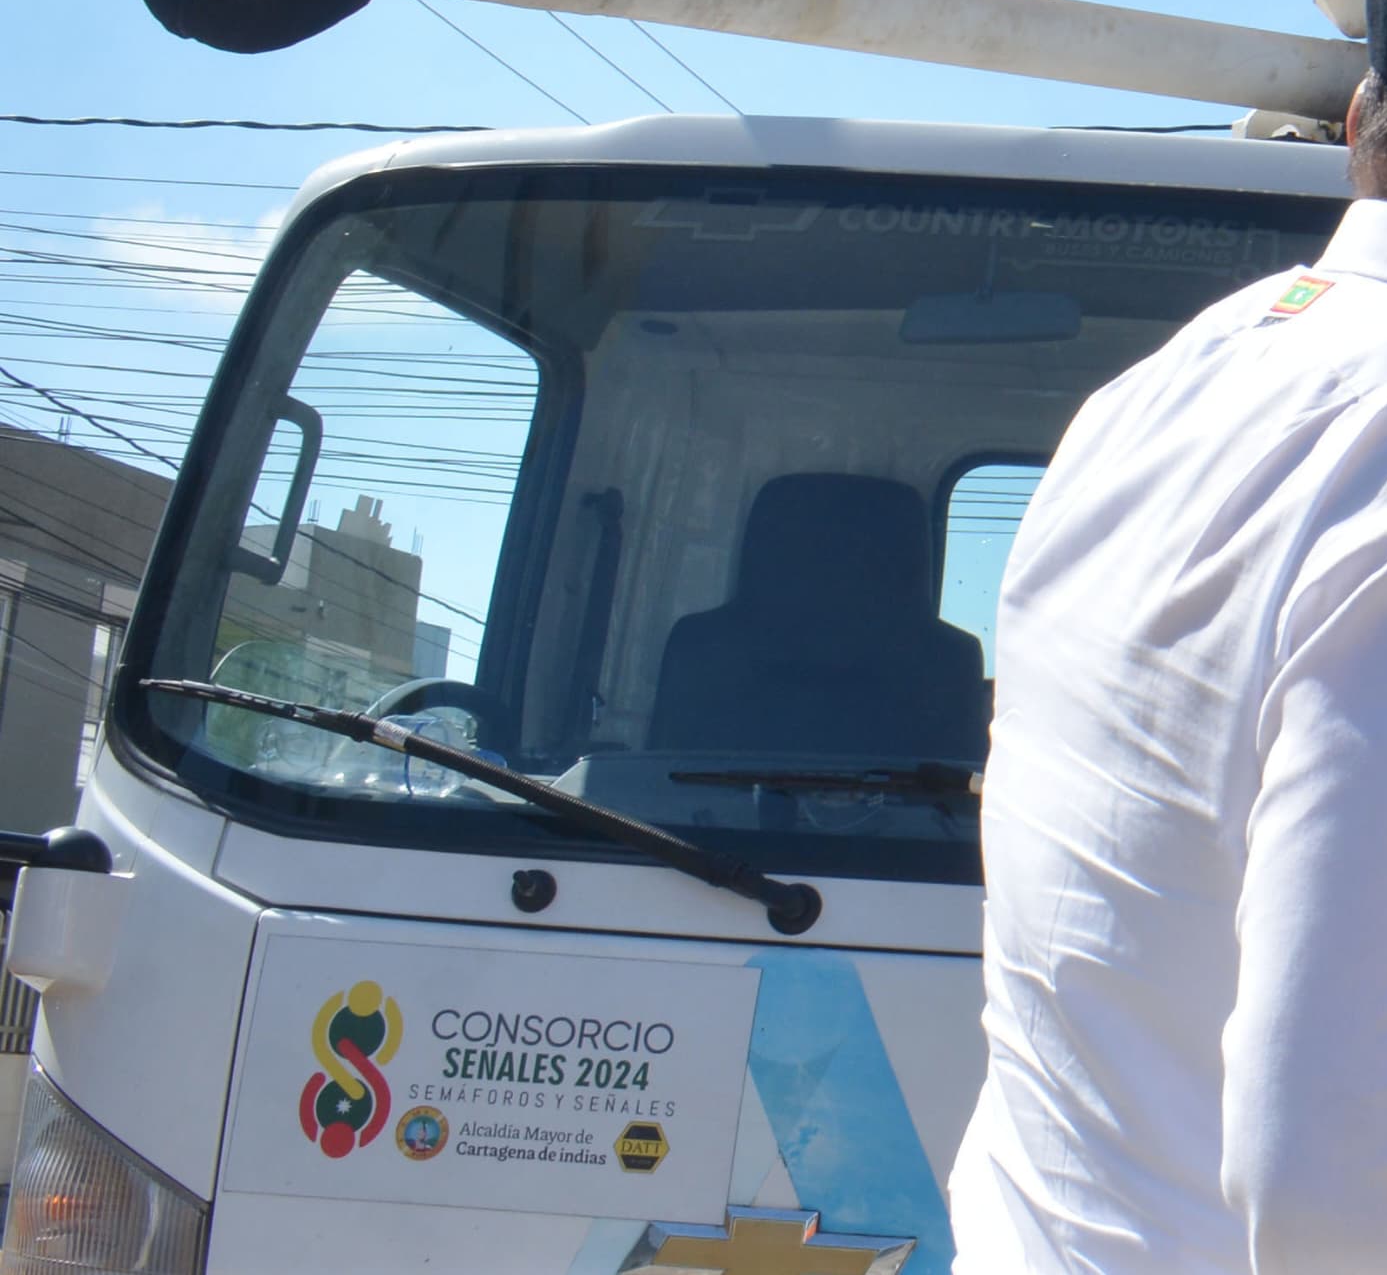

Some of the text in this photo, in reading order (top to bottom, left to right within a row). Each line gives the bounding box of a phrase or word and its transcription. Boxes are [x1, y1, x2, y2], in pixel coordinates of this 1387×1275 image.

[838, 204, 1242, 248] COUNTRY MOTORS
[1125, 245, 1234, 265] CAMIONES
[431, 1009, 675, 1055] CONSORCIO
[442, 1043, 650, 1092] SEÑALES 2024
[408, 1083, 676, 1117] SEMÁFOROS Y SEÑALES
[459, 1122, 594, 1145] Alcaldía Mayor de
[456, 1141, 607, 1166] Cartagena de indias
